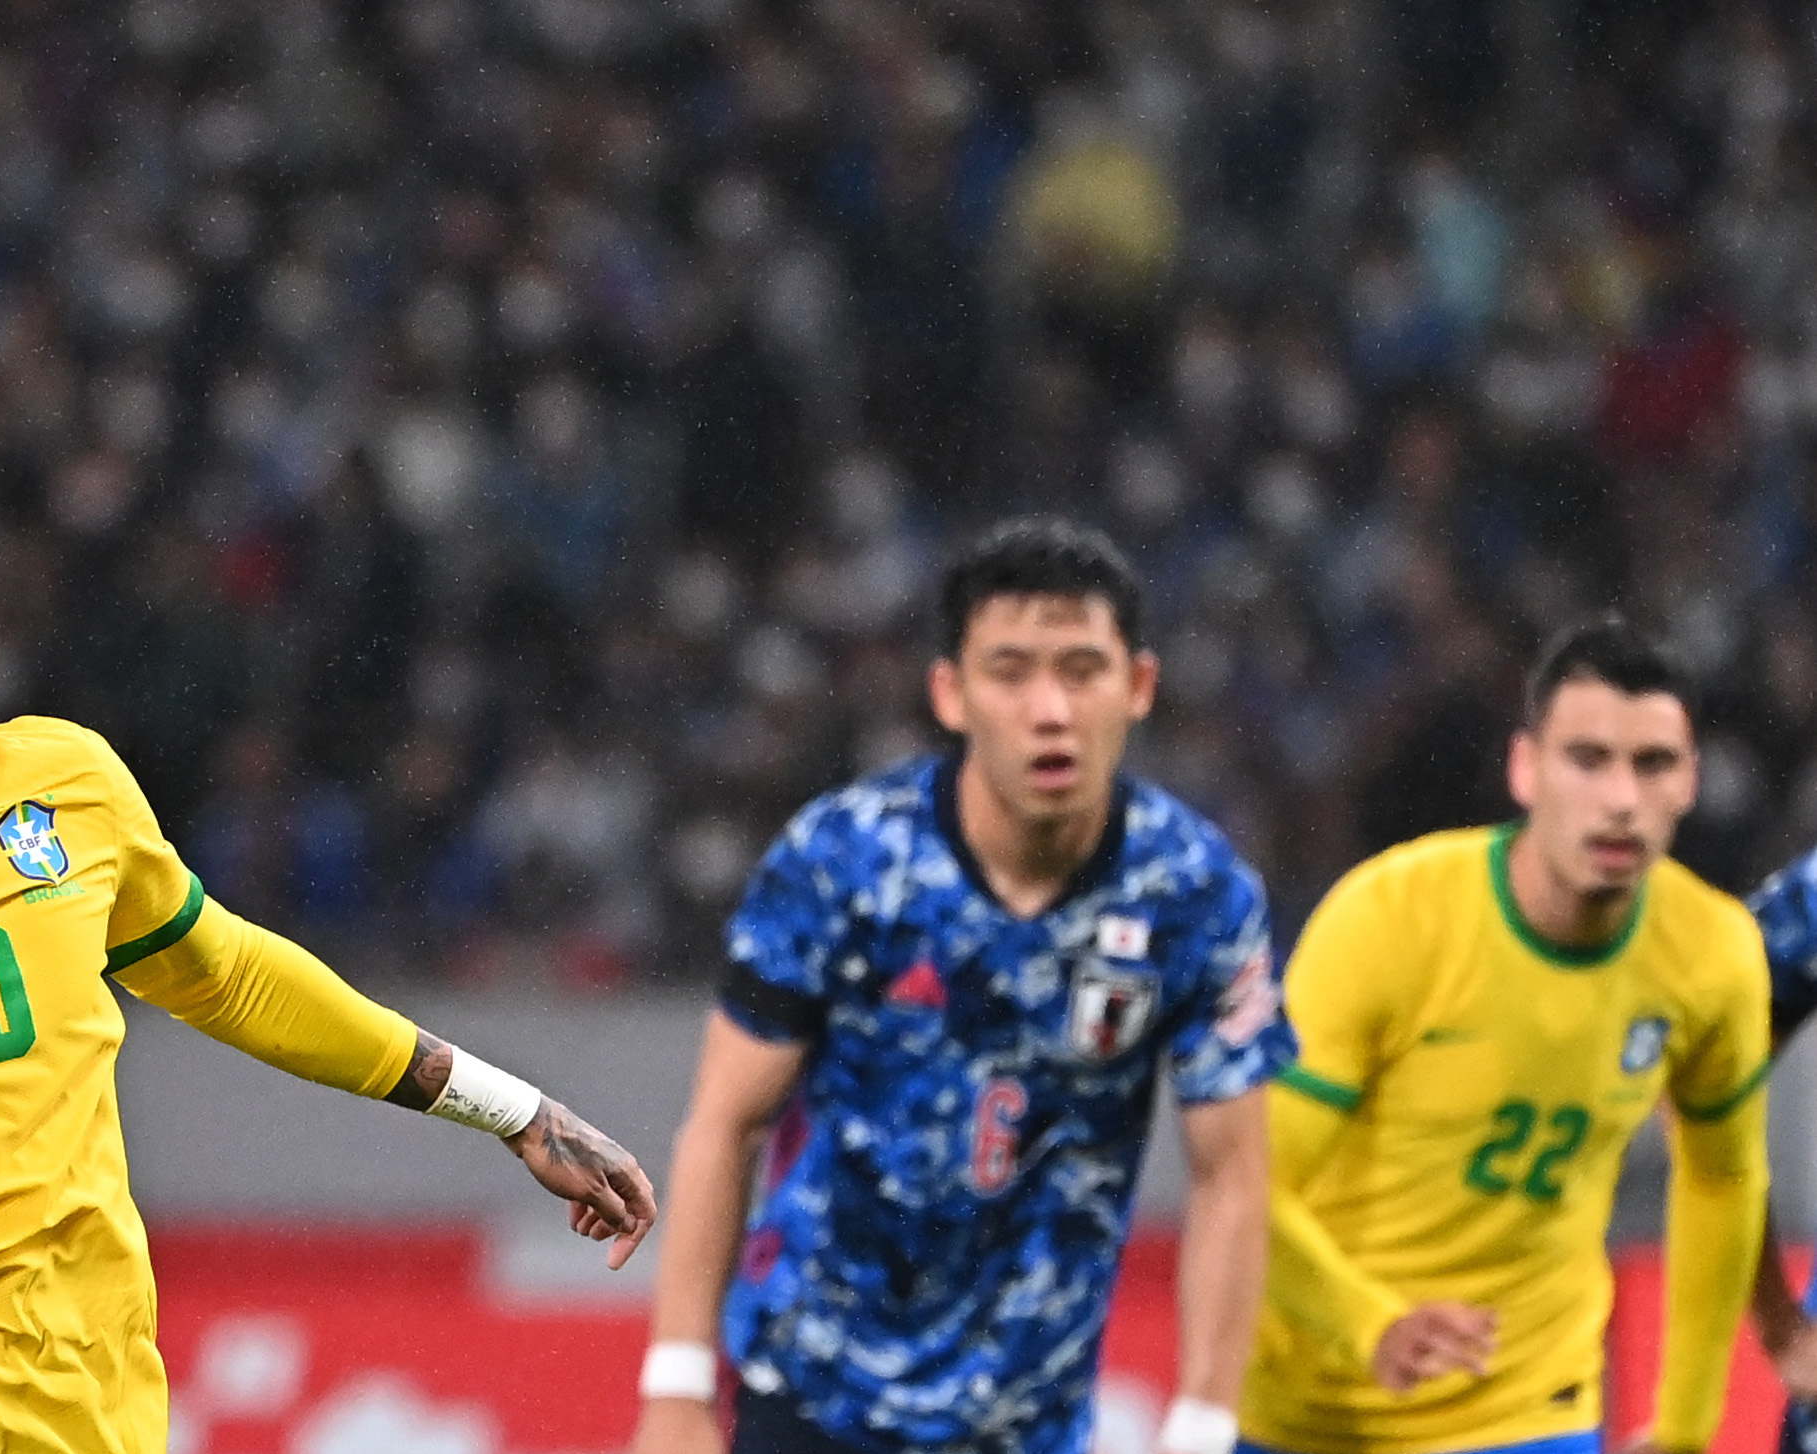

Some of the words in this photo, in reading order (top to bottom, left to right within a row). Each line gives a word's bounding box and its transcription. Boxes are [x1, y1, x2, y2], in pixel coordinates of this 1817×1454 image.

[18, 835, 42, 851] CBF
[971, 1077, 1029, 1197] 6
[1465, 1098, 1591, 1202] 22
